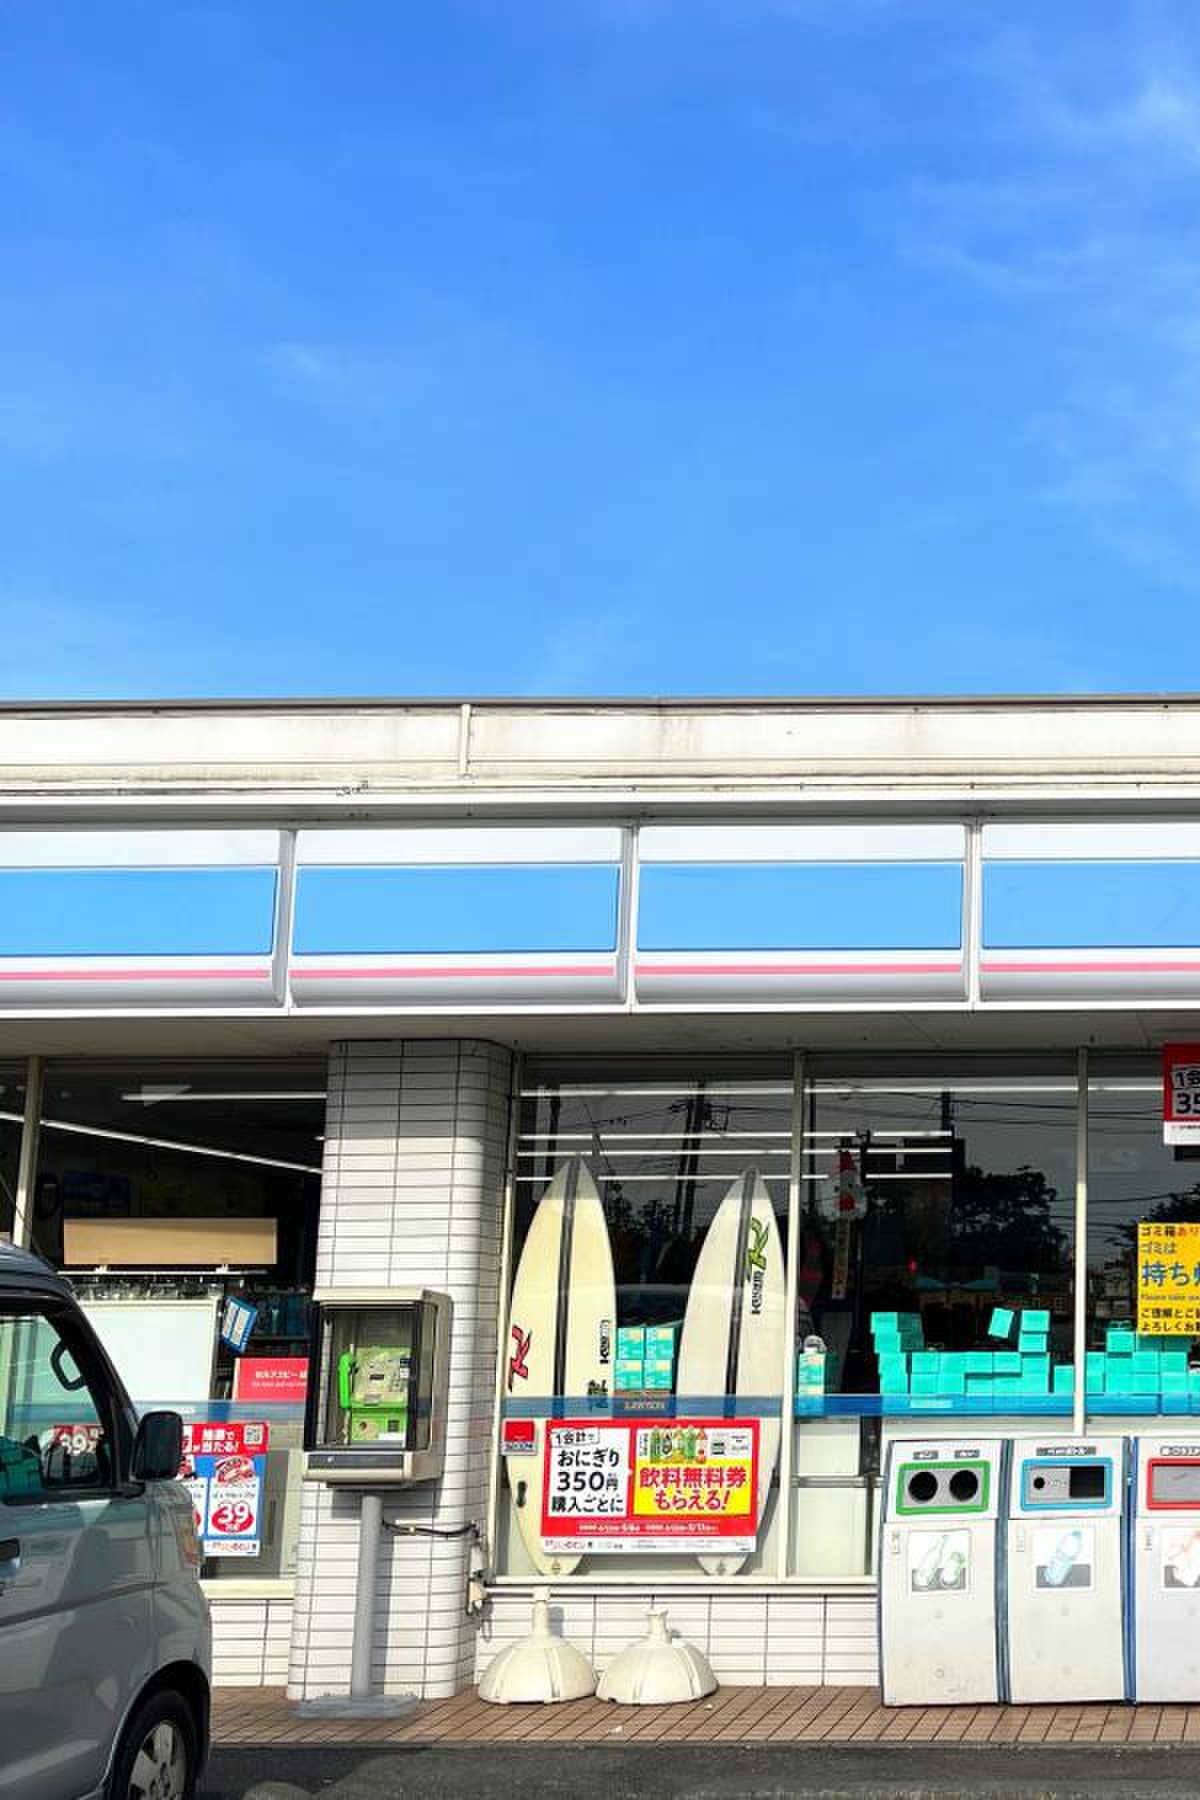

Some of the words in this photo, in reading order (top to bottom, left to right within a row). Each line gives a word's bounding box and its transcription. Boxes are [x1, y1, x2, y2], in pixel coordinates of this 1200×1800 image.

[1141, 1241, 1177, 1254] ゴミは
[557, 1447, 620, 1468] おにぎり
[557, 1471, 619, 1492] 350円
[639, 1467, 747, 1489] 飲料無料券
[551, 1494, 624, 1513] 購入ごとに
[654, 1489, 731, 1511] もらえる!
[218, 1501, 250, 1524] 39
